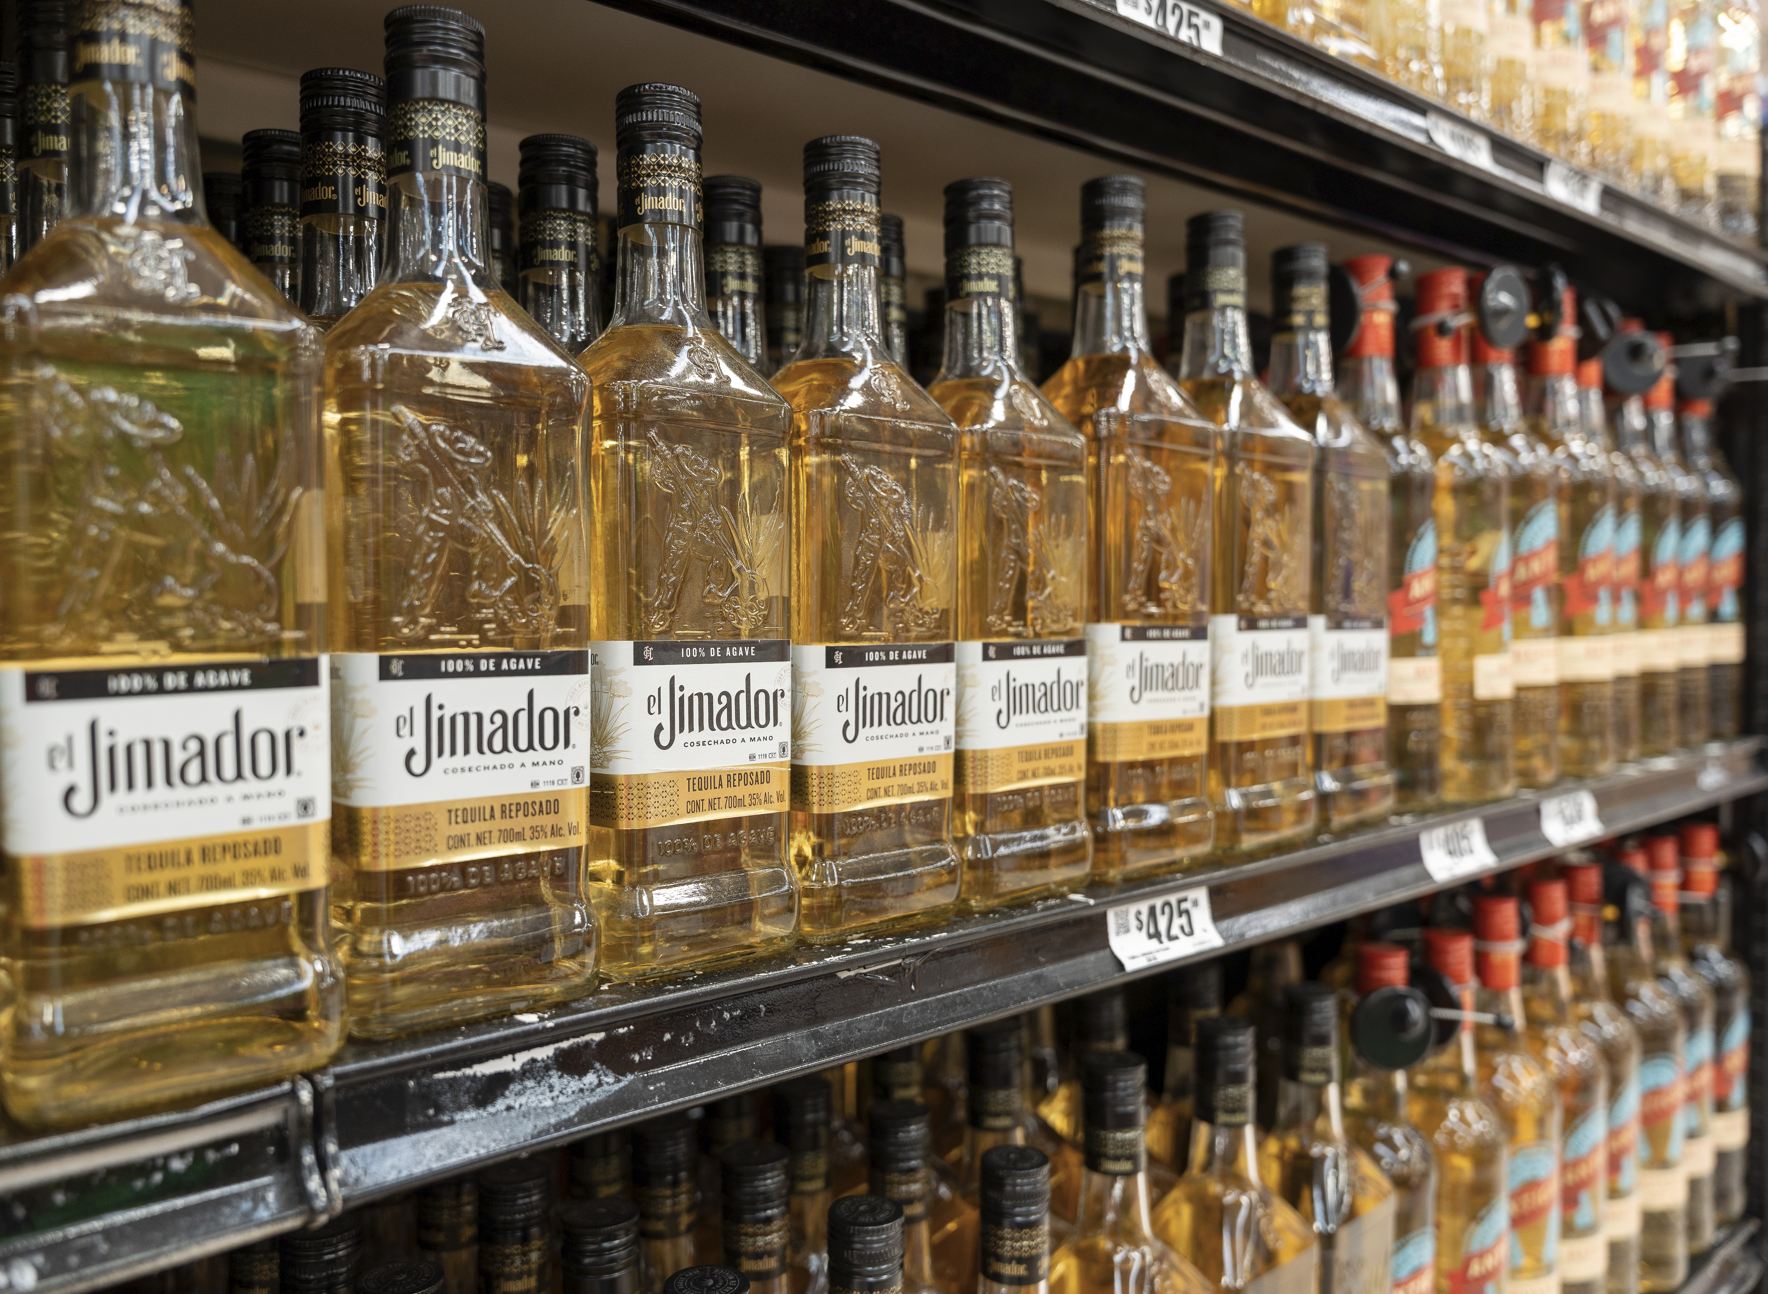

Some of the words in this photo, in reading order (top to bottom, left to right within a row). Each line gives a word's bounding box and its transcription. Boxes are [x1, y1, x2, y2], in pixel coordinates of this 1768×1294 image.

[432, 143, 481, 173] Jimador
[637, 191, 685, 215] Jimador
[440, 659, 474, 673] 100%
[480, 658, 496, 671] DE
[502, 657, 541, 670] AGAVE
[681, 647, 706, 658] 100%
[710, 647, 721, 657] DE
[726, 646, 756, 656] AGAVE
[865, 651, 886, 661] 100%
[889, 650, 900, 660] DE
[902, 649, 927, 660] AGAVE
[108, 673, 159, 694] 100%
[163, 671, 189, 691] DE
[195, 668, 252, 689] AGAVE
[1130, 650, 1204, 705] Jimador
[647, 686, 662, 715] el
[653, 672, 786, 751] Jimador
[836, 687, 849, 713] el
[842, 673, 951, 744] Jimador
[991, 679, 1001, 702] el
[996, 666, 1084, 729] Jimador
[396, 705, 415, 738] el
[404, 687, 581, 778] Jimador
[683, 738, 737, 748] COSECHADO
[749, 735, 774, 743] MANO
[48, 733, 74, 772] el
[63, 706, 307, 819] Jimador
[443, 763, 515, 775] COSECHADO
[532, 759, 564, 767] MANO
[867, 765, 896, 781] TEQUILA
[899, 760, 937, 776] REPOSADO
[686, 774, 724, 792] TEQUILA
[726, 769, 771, 789] REPOSADO
[448, 804, 496, 825] TEQUILA
[501, 798, 560, 820] REPOSADO
[686, 799, 707, 814] CONT.
[708, 796, 723, 811] NET.
[724, 795, 747, 810] 700mL
[748, 792, 762, 807] 35%
[763, 791, 775, 805] Alc.
[447, 832, 474, 850] CONT.
[476, 830, 495, 846] NET.
[498, 826, 527, 843] 700mL
[529, 824, 547, 840] 35%
[550, 823, 565, 838] Alc.
[567, 821, 582, 836] Vol.
[124, 847, 196, 875] TEQUILA
[201, 836, 282, 865] REPOSADO
[1135, 896, 1195, 945] $425
